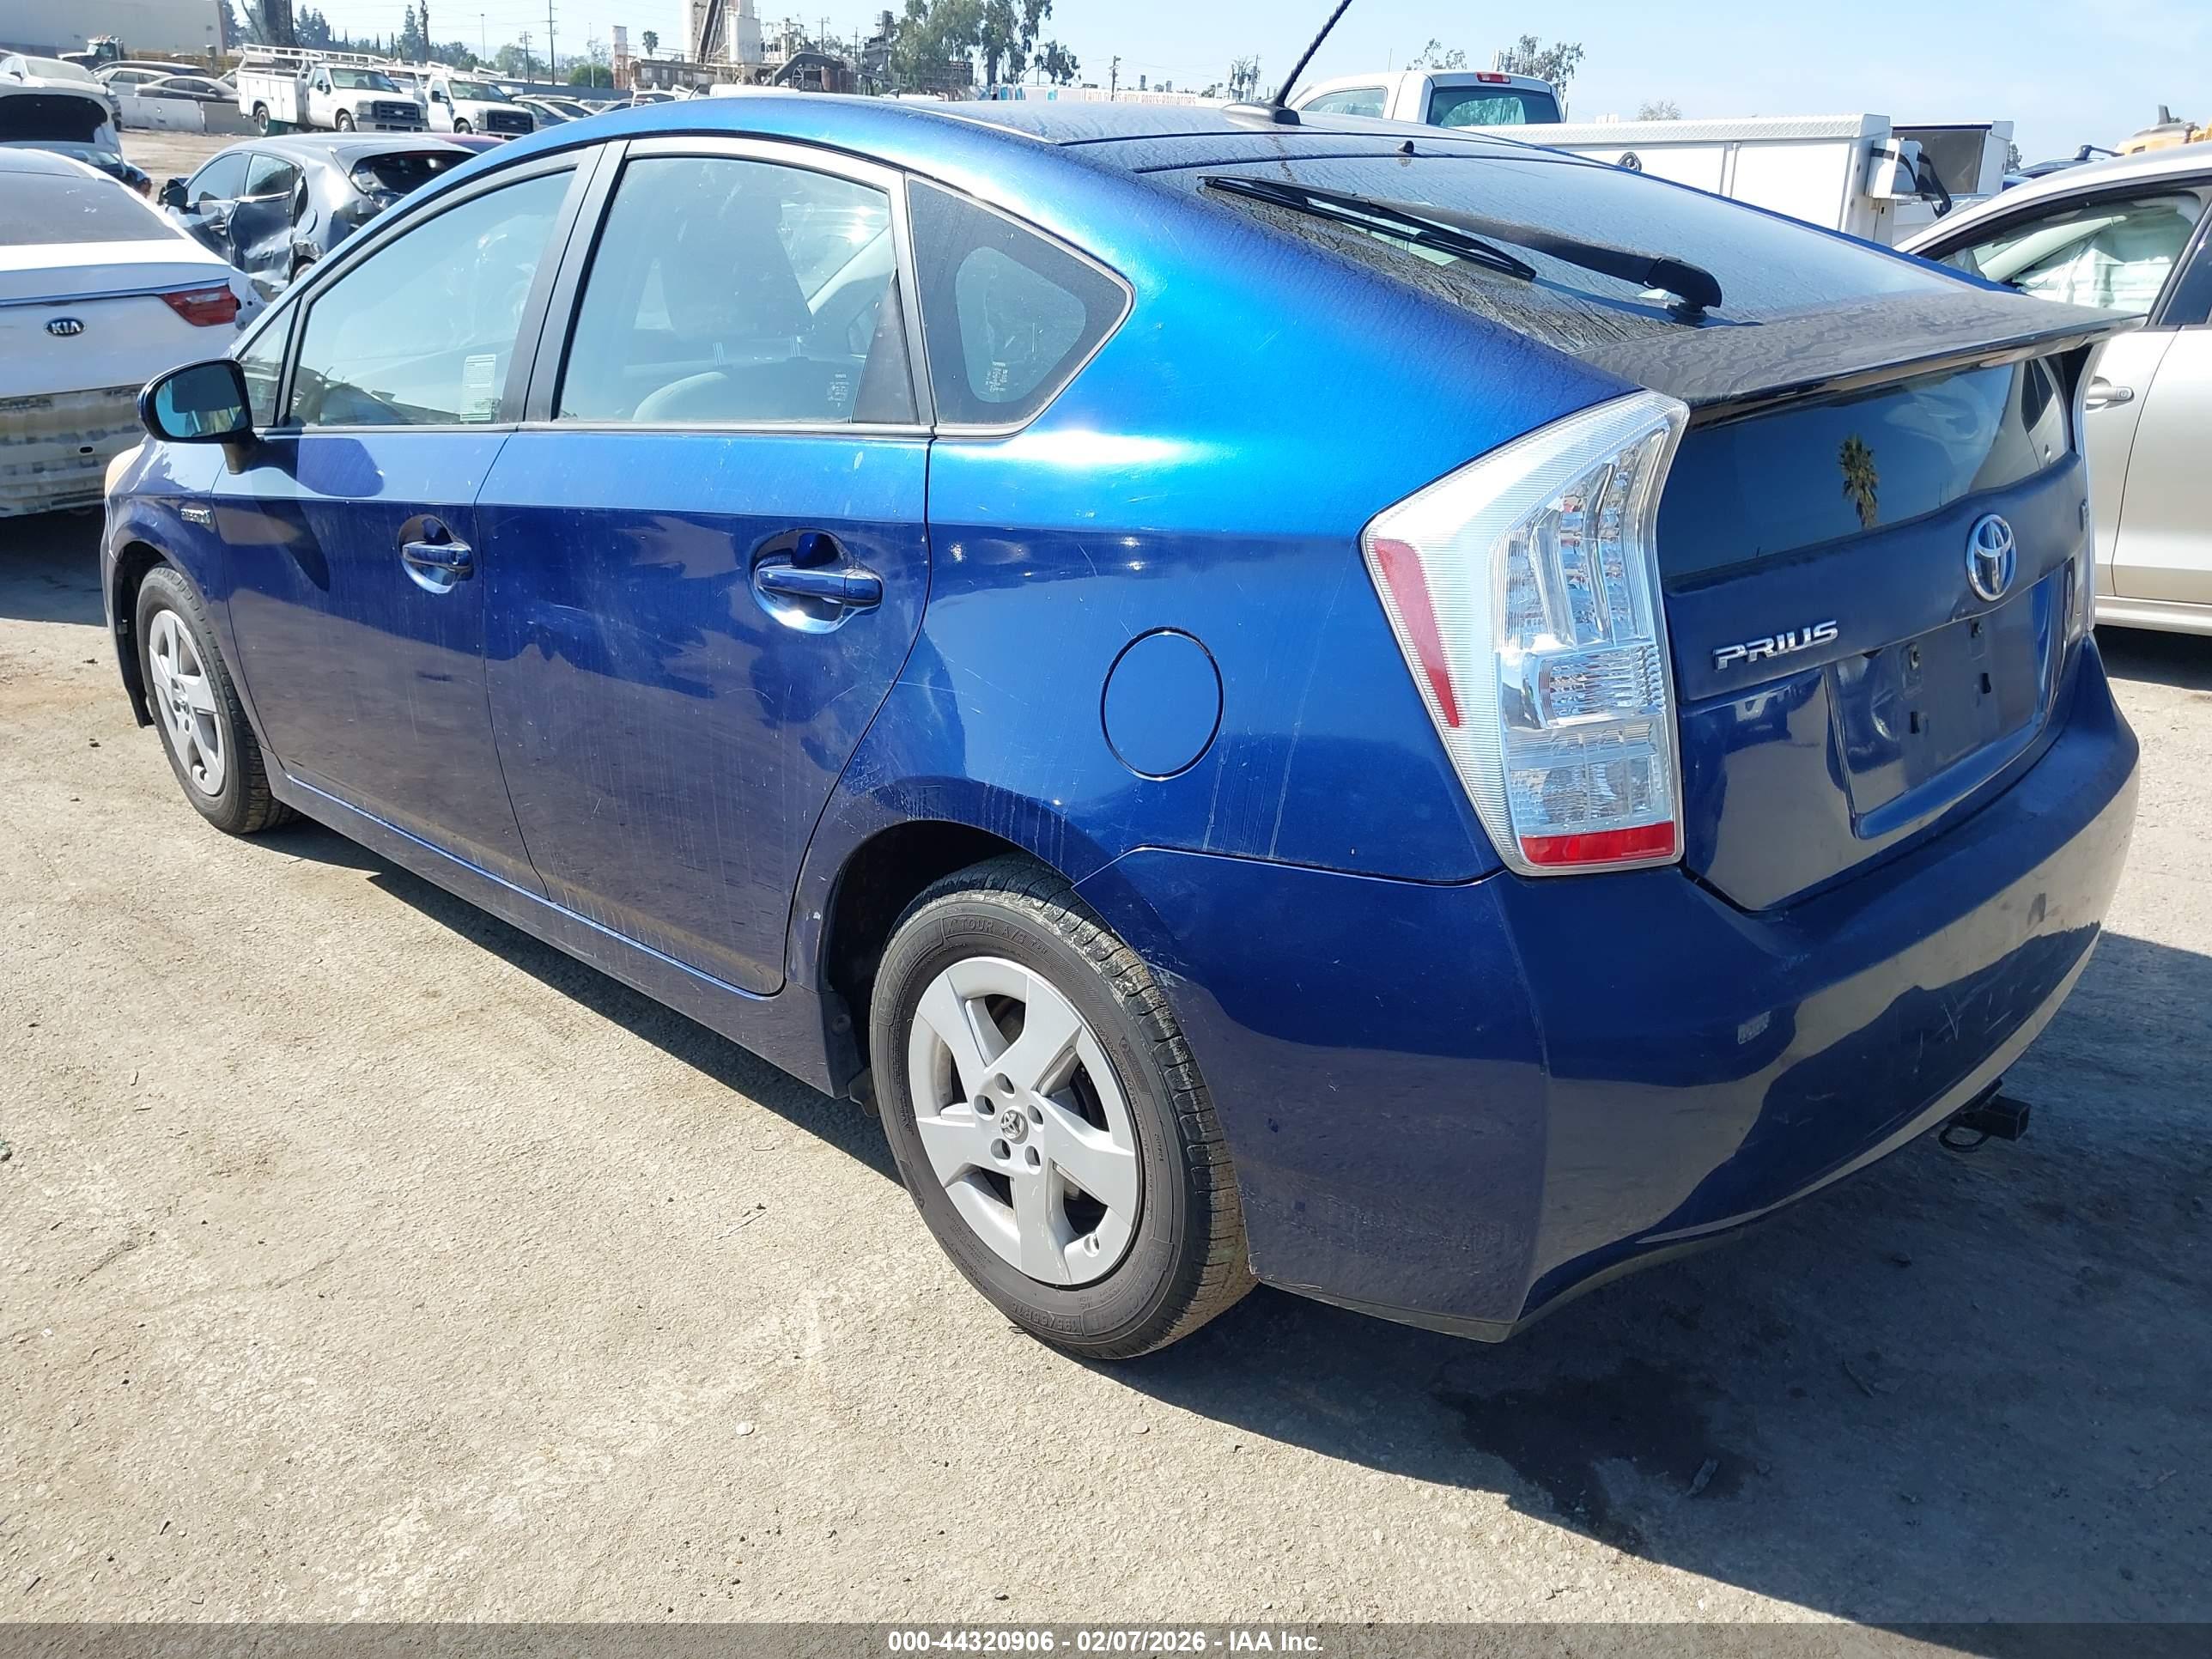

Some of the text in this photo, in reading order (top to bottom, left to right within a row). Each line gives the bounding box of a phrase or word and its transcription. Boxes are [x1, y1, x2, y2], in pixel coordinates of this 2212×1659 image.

[1087, 90, 1102, 101] AUTO
[51, 320, 82, 335] KIA
[1713, 620, 1839, 672] PRIUS
[960, 918, 994, 934] TOUR
